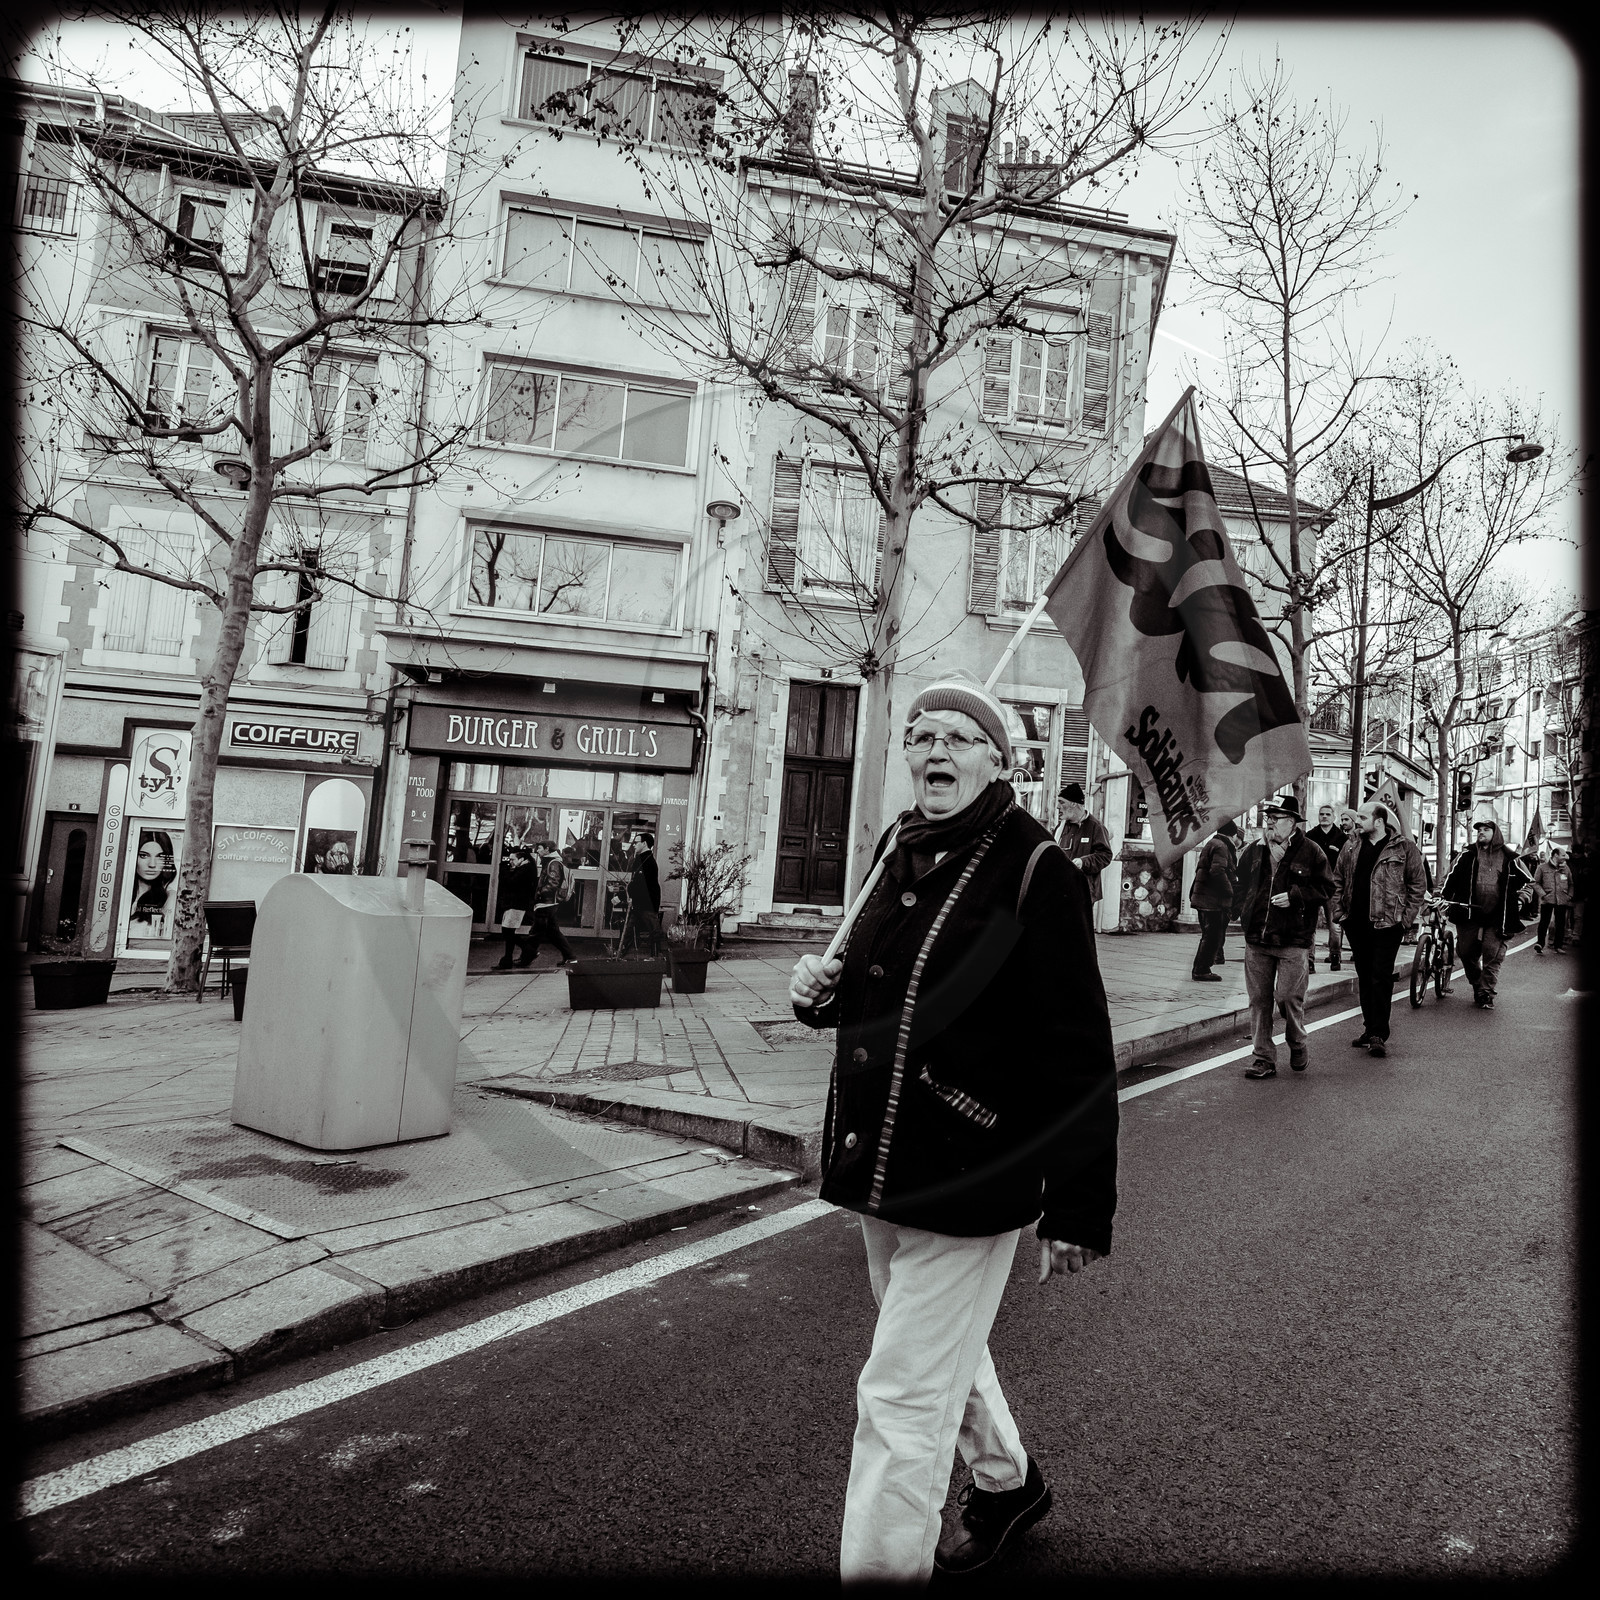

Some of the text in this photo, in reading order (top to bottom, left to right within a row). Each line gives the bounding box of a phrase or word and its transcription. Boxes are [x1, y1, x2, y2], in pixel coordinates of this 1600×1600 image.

[824, 669, 830, 677] 7
[234, 724, 356, 749] COIFFURE
[446, 715, 658, 758] BURGER & GRILL'S
[327, 747, 354, 755] MIXTE
[1124, 705, 1201, 845] Solidaires
[408, 776, 426, 786] FAST
[415, 787, 435, 797] FOOD
[98, 804, 121, 912] COIFFURE
[217, 853, 287, 864] coiffure création
